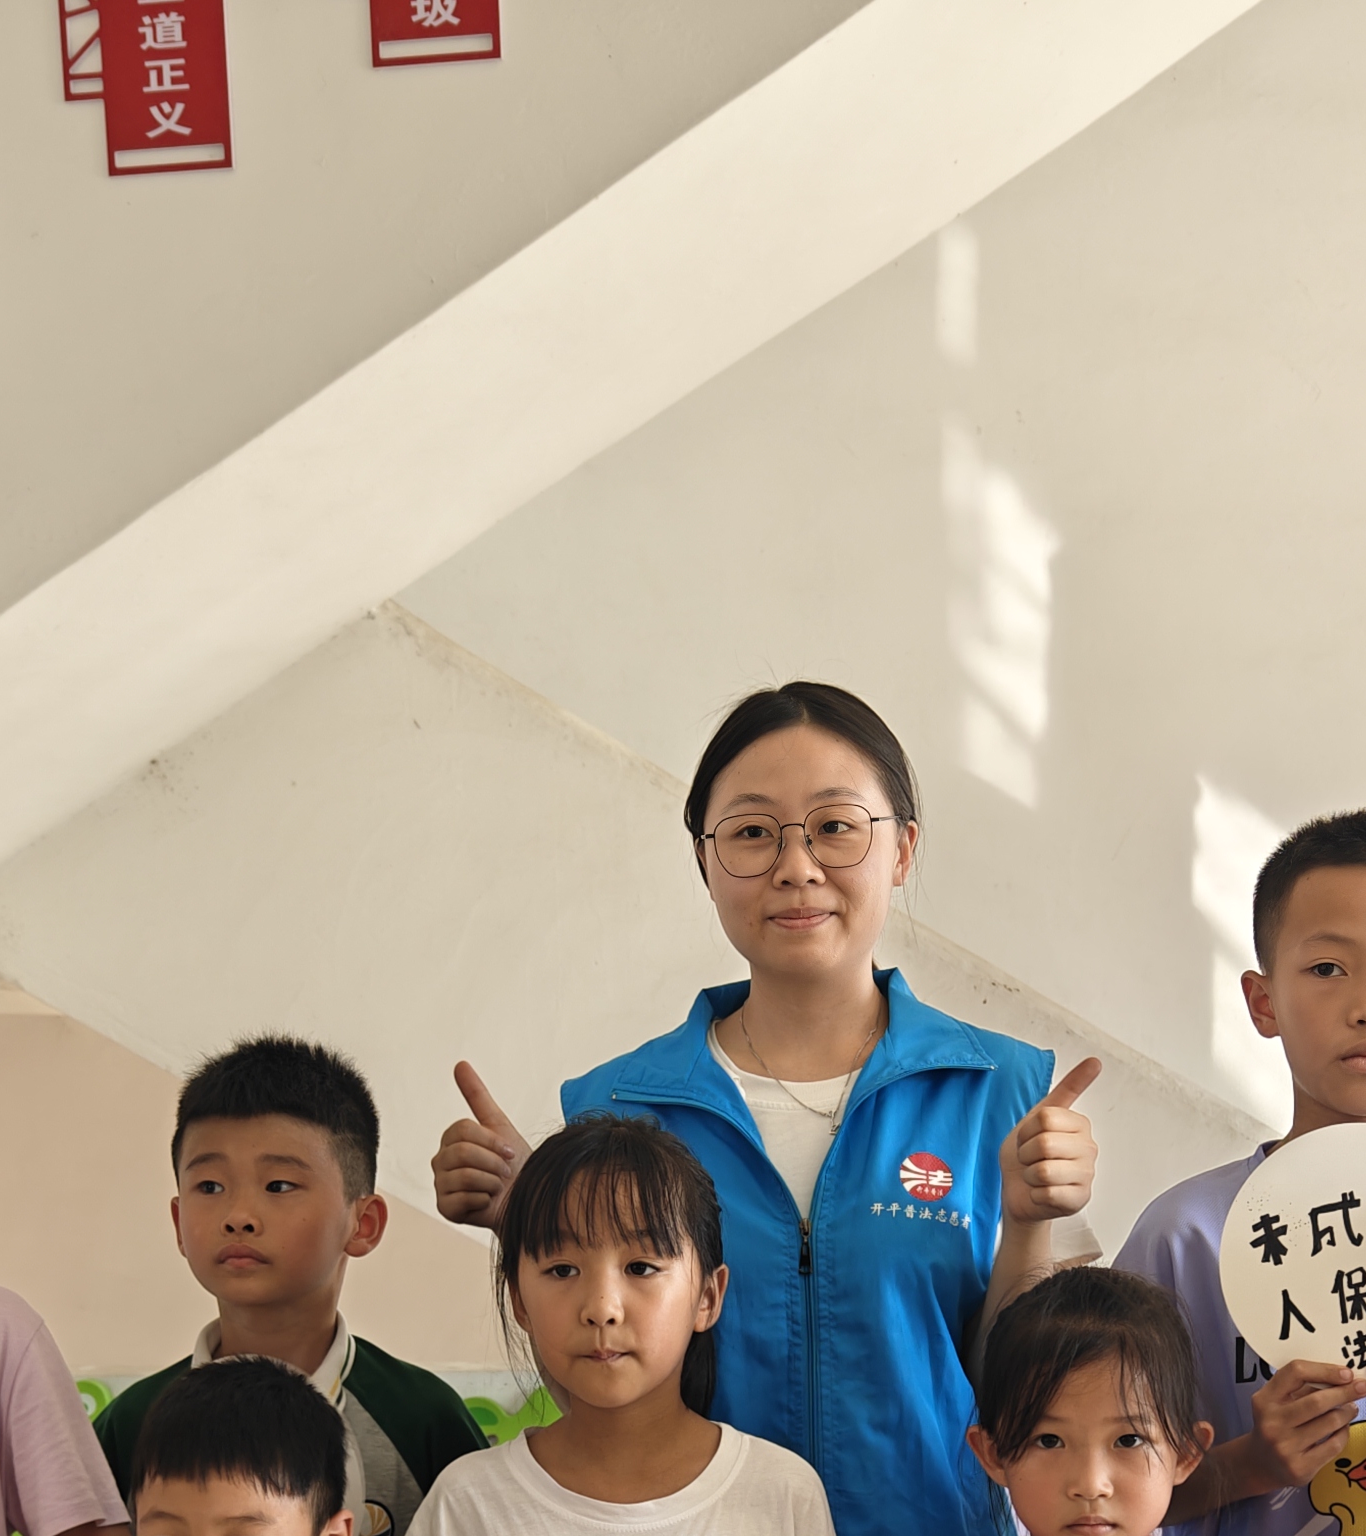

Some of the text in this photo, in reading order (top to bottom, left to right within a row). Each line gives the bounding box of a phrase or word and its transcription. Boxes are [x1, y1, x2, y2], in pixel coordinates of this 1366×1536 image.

[137, 0, 193, 139] 道正义
[870, 1202, 972, 1230] 开平普法志愿者
